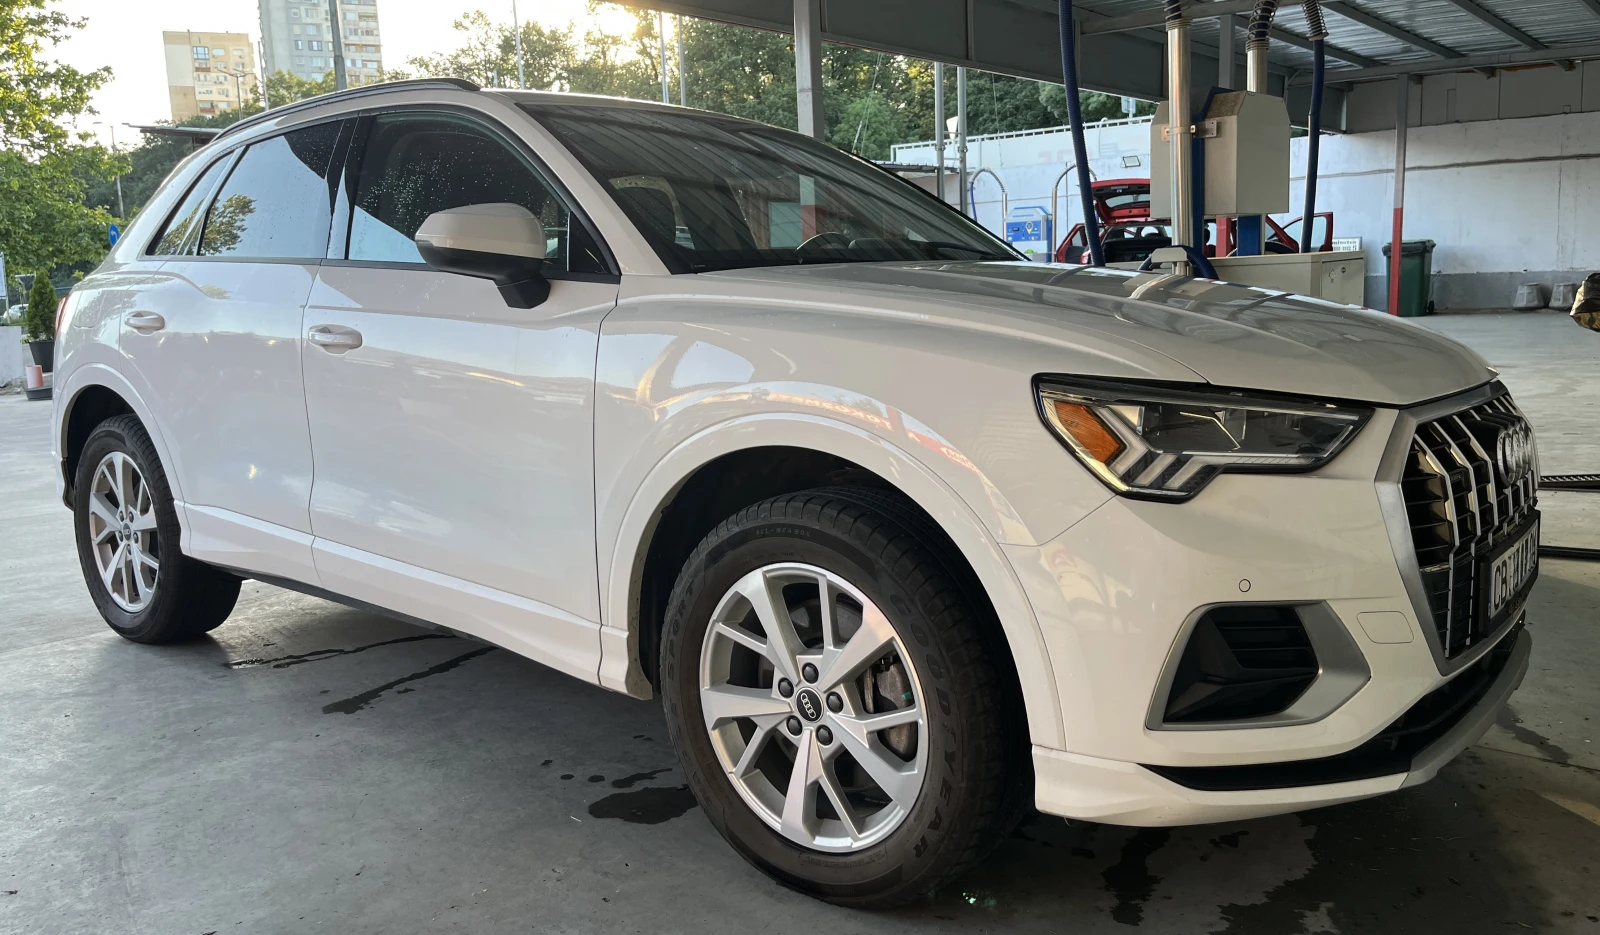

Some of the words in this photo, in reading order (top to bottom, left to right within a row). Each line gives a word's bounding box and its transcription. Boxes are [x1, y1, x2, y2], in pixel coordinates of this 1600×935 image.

[755, 526, 812, 538] ALL-SEASON
[666, 578, 697, 681] SPORT
[888, 592, 956, 859] GOODYEAR
